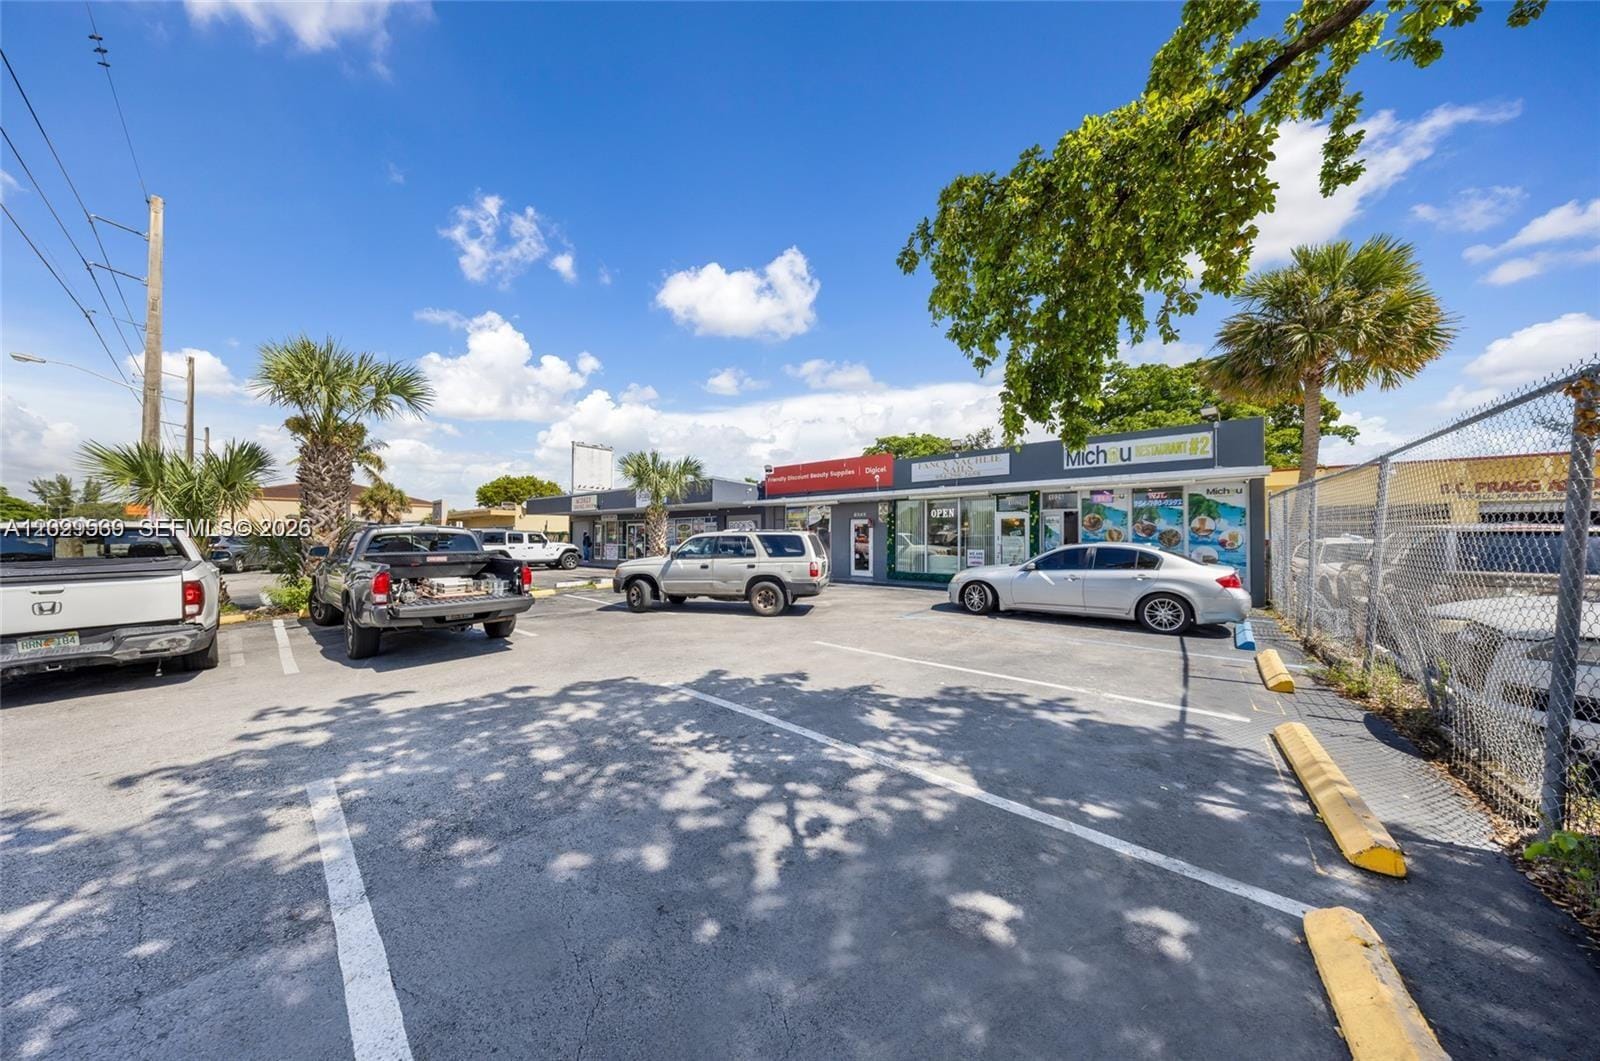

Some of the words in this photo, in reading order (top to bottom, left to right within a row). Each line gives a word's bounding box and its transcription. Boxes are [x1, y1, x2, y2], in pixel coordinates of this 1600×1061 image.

[1066, 445, 1131, 467] Michou
[1135, 441, 1187, 457] RESTAURANT
[1189, 436, 1210, 456] #2
[830, 469, 855, 478] Supplies
[865, 466, 887, 474] Digicel
[931, 508, 955, 518] OPEN
